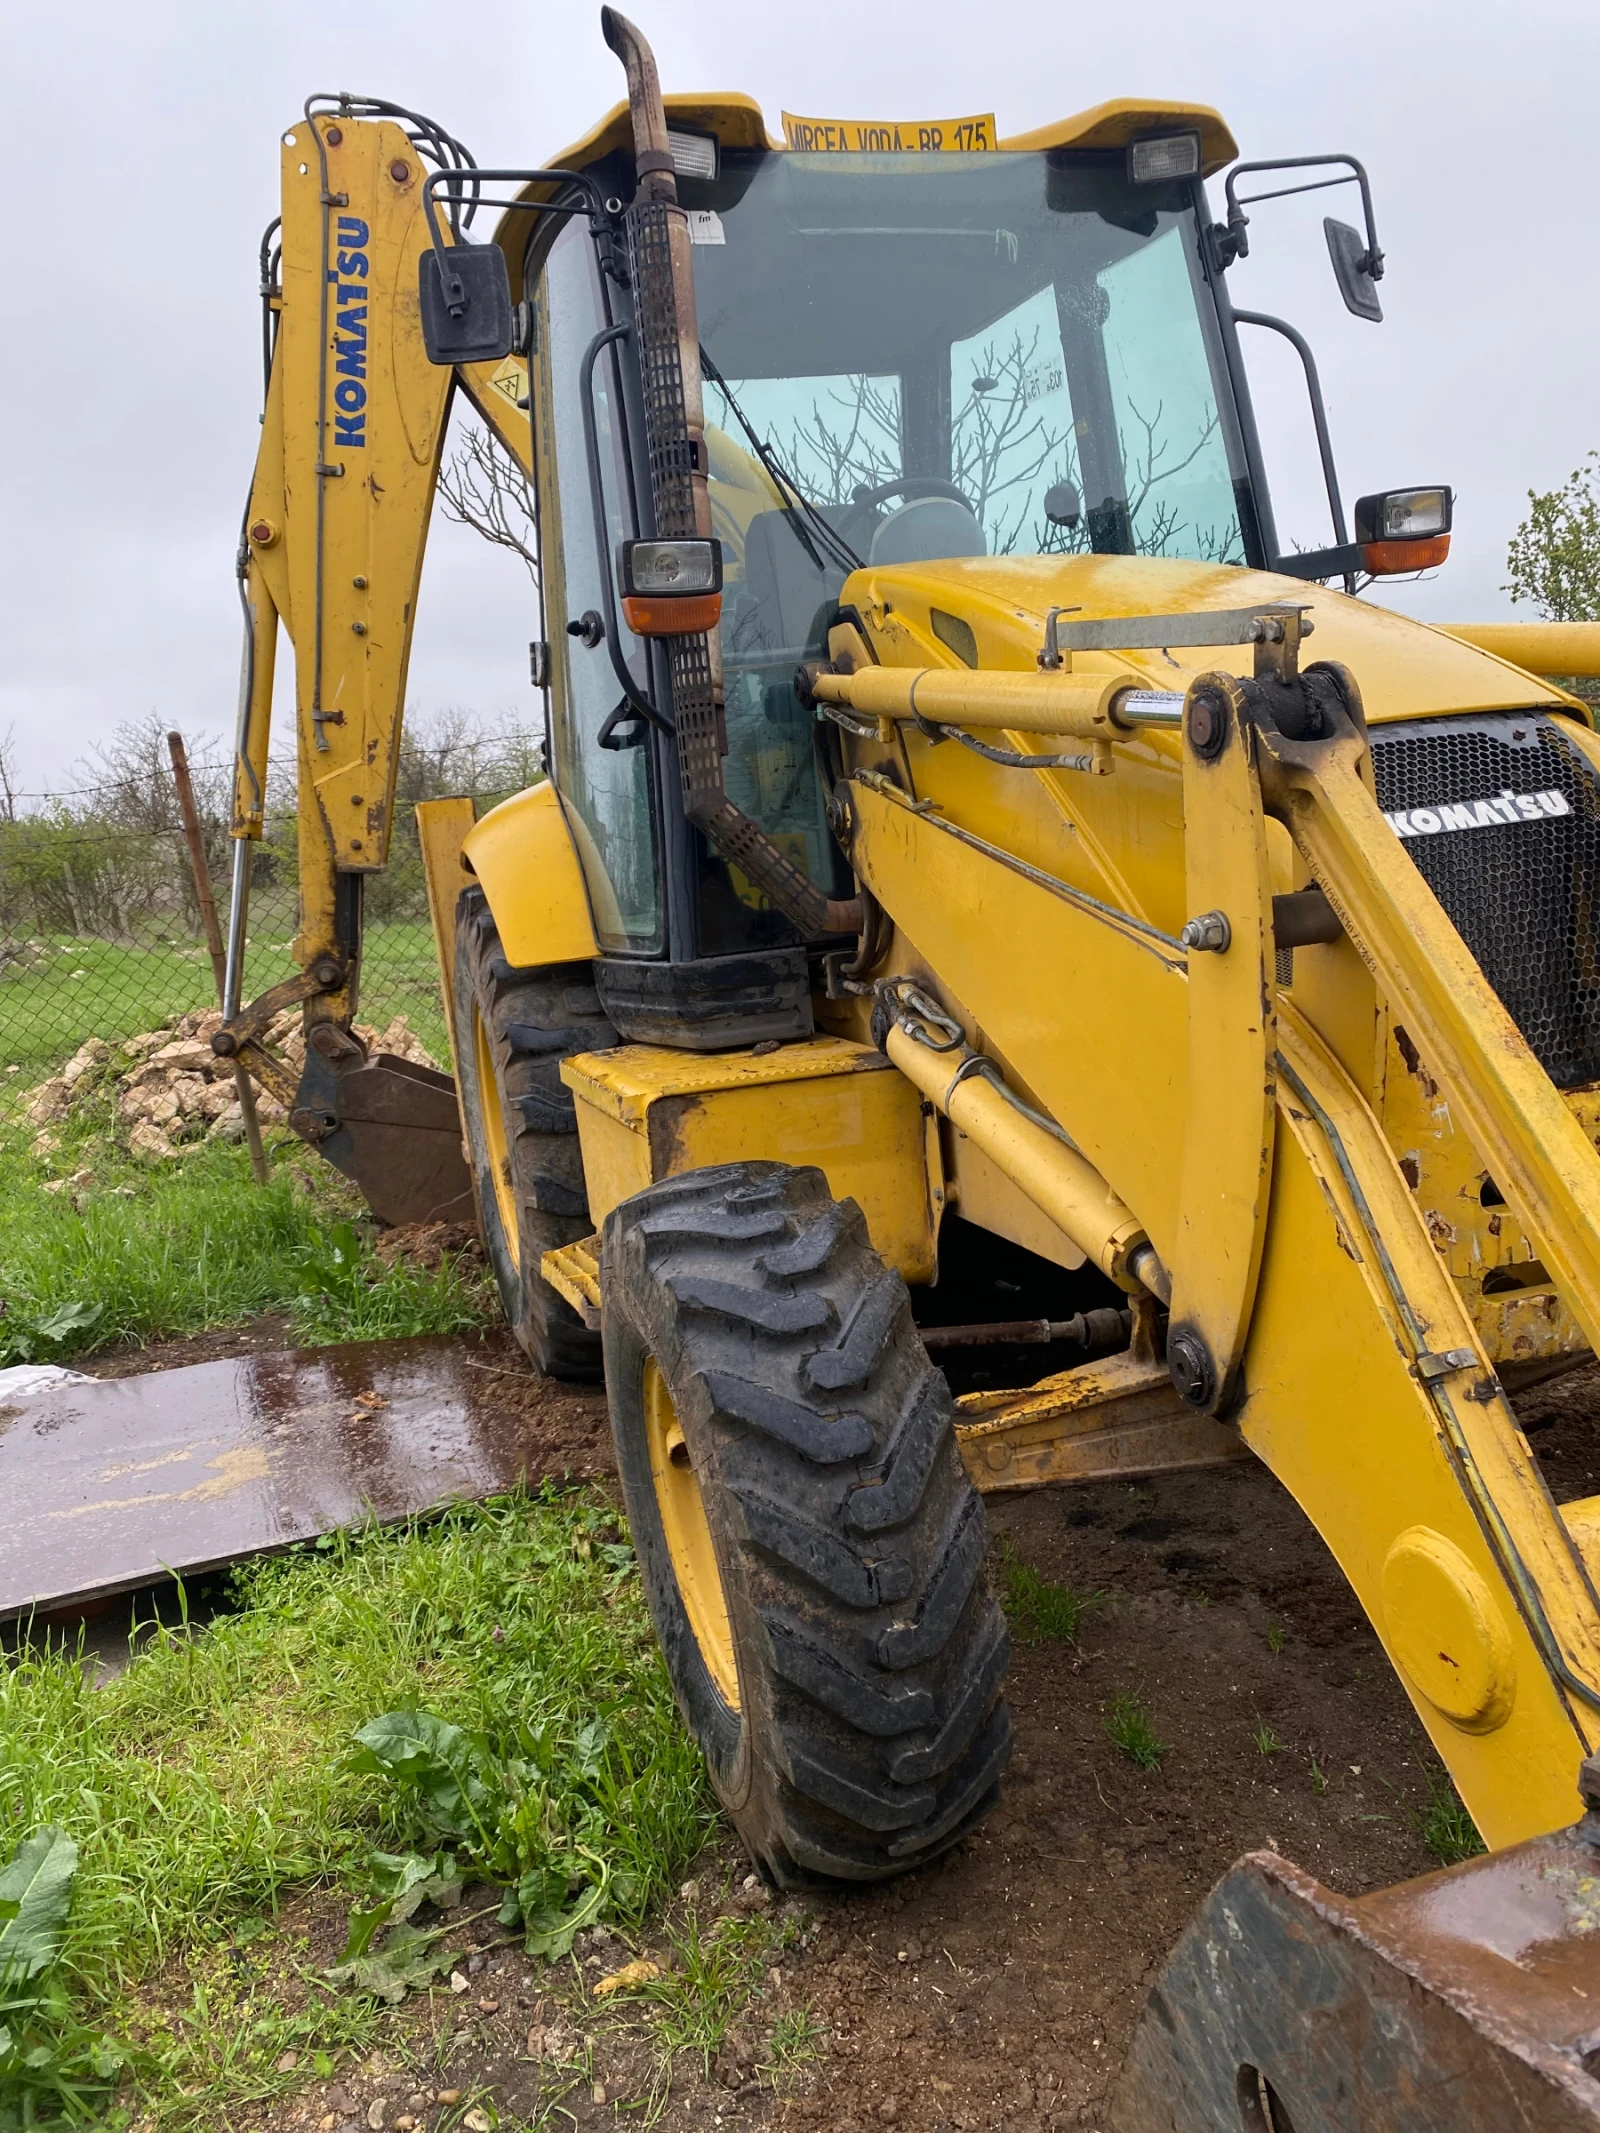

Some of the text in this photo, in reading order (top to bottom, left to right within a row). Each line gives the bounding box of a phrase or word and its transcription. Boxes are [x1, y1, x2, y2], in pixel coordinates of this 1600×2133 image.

[787, 121, 848, 150] MIRCEA
[953, 121, 987, 150] 175
[327, 216, 370, 448] KOMATSU
[1384, 789, 1569, 837] KOMATSU
